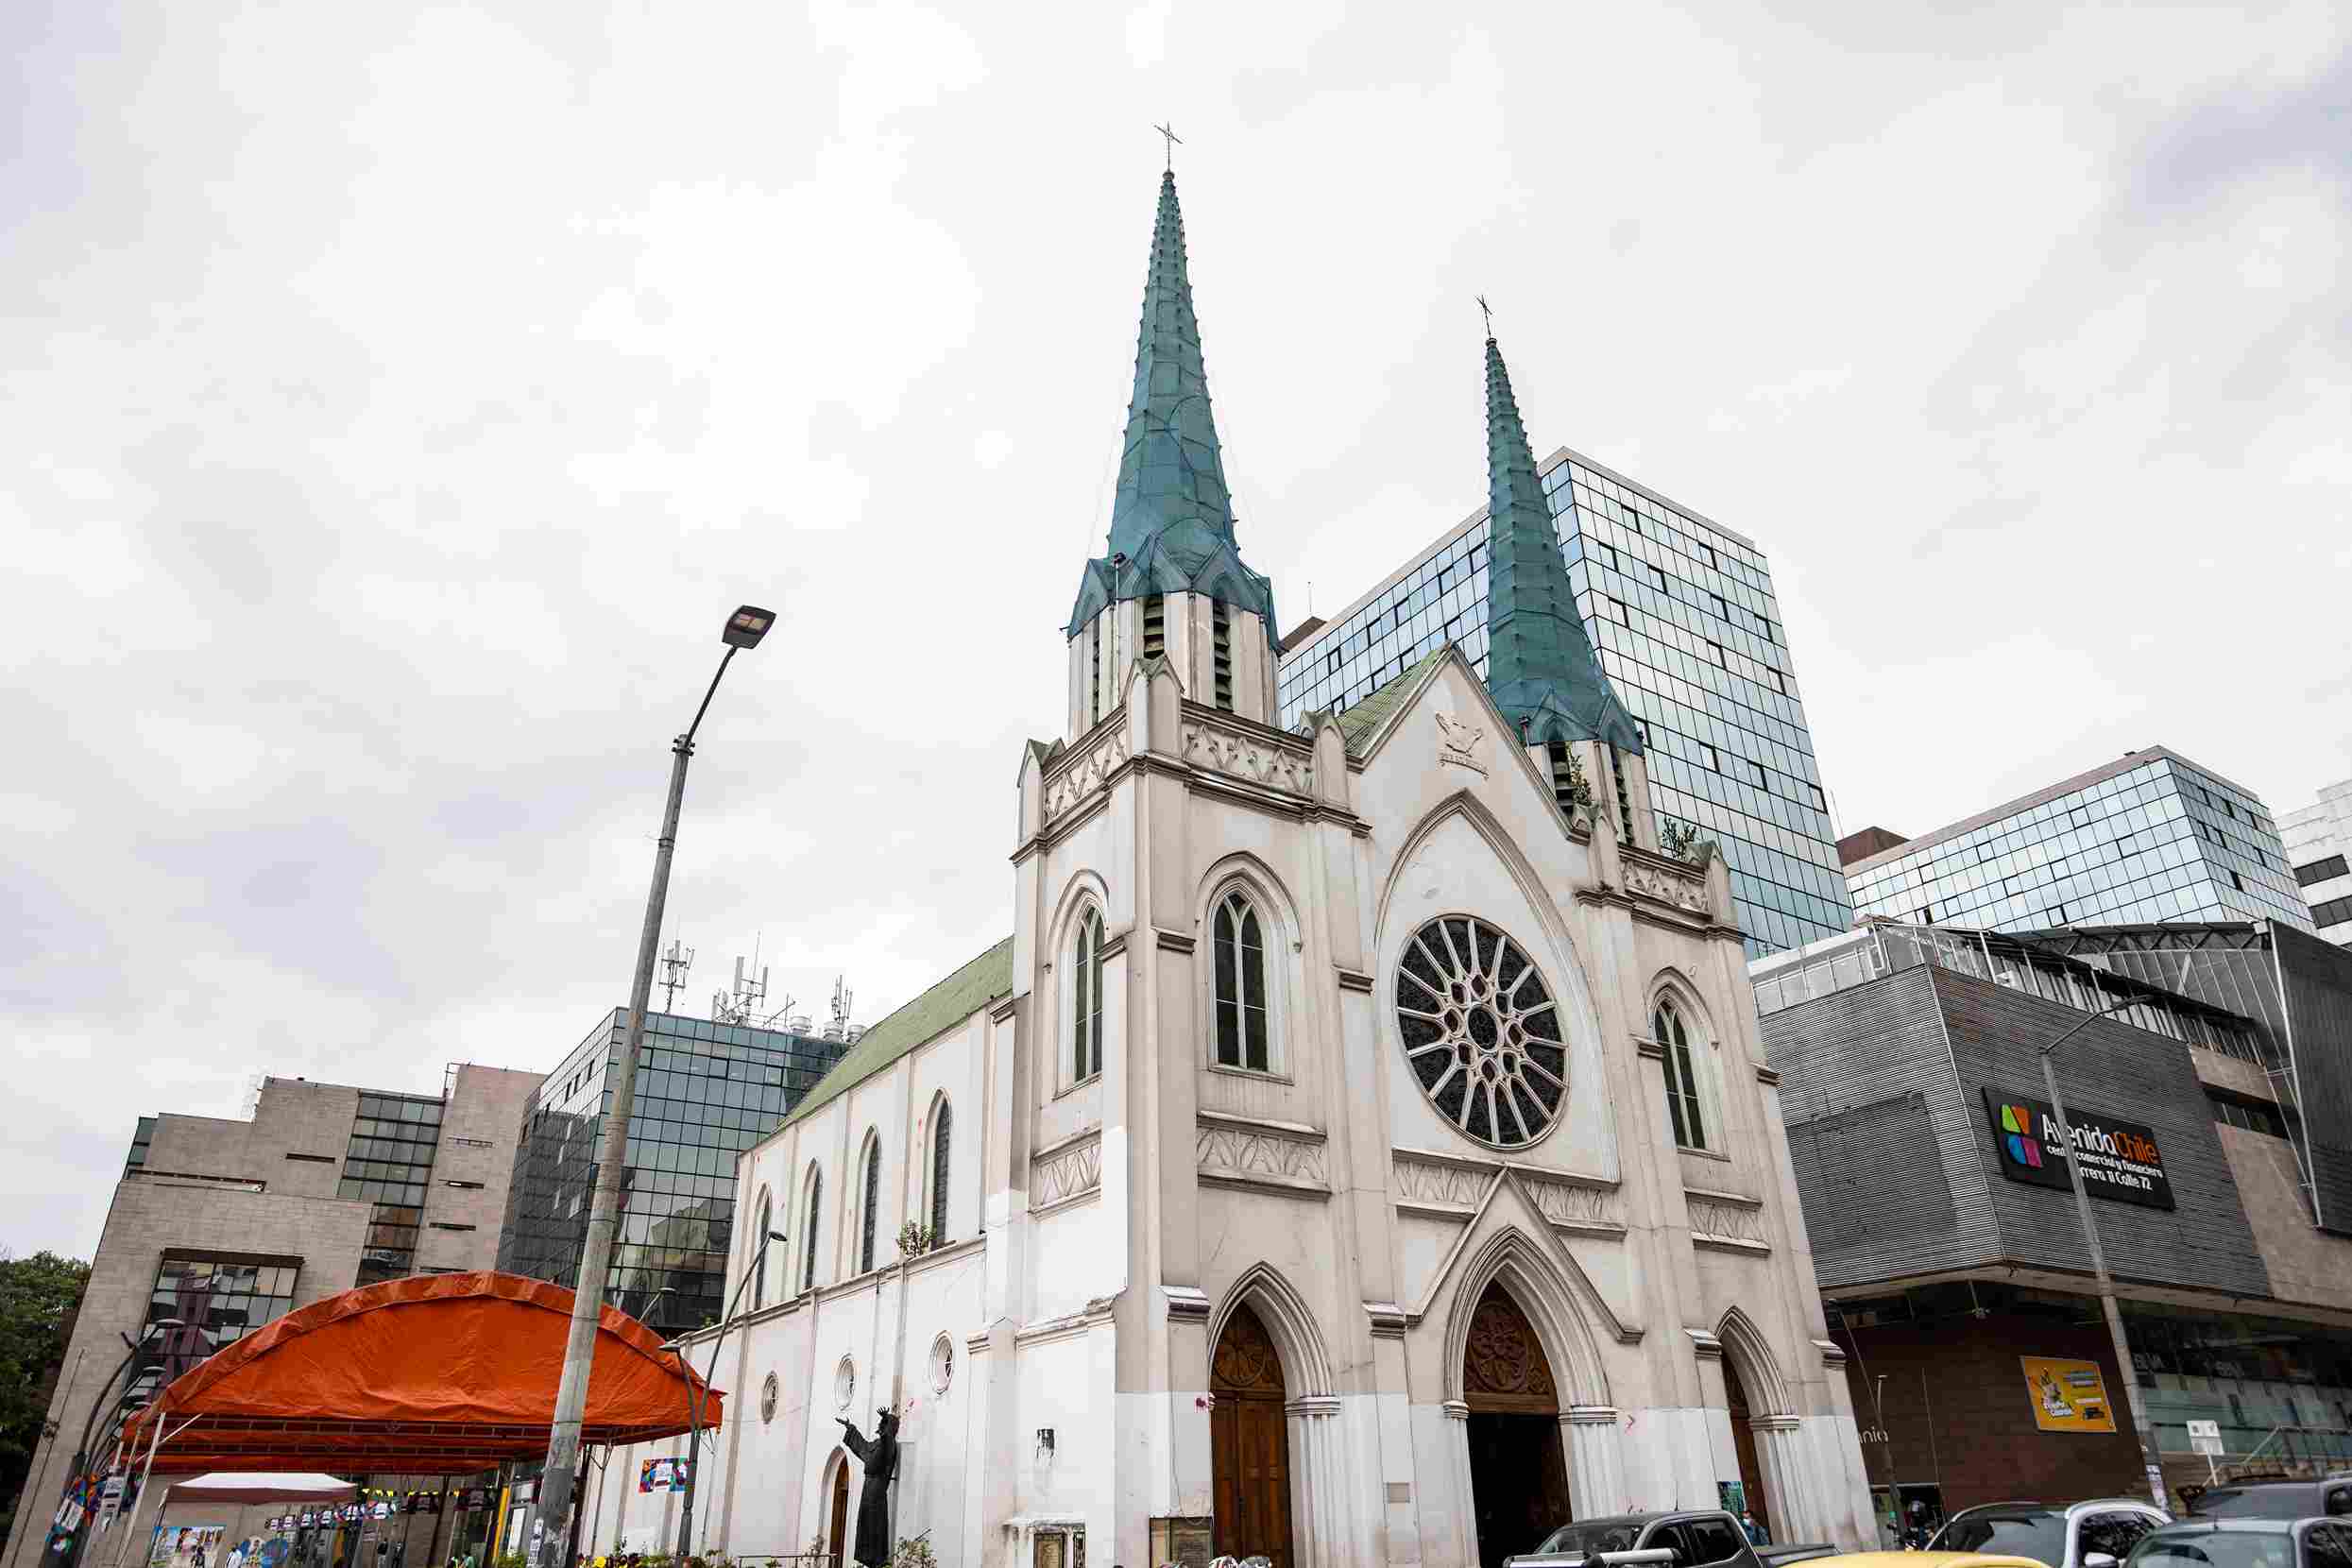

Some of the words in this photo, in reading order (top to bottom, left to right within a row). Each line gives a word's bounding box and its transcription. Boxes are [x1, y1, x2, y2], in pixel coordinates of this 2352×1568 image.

[2079, 1167, 2106, 1182] rrera
[2115, 1171, 2140, 1187] Calle
[2139, 1176, 2154, 1190] 72
